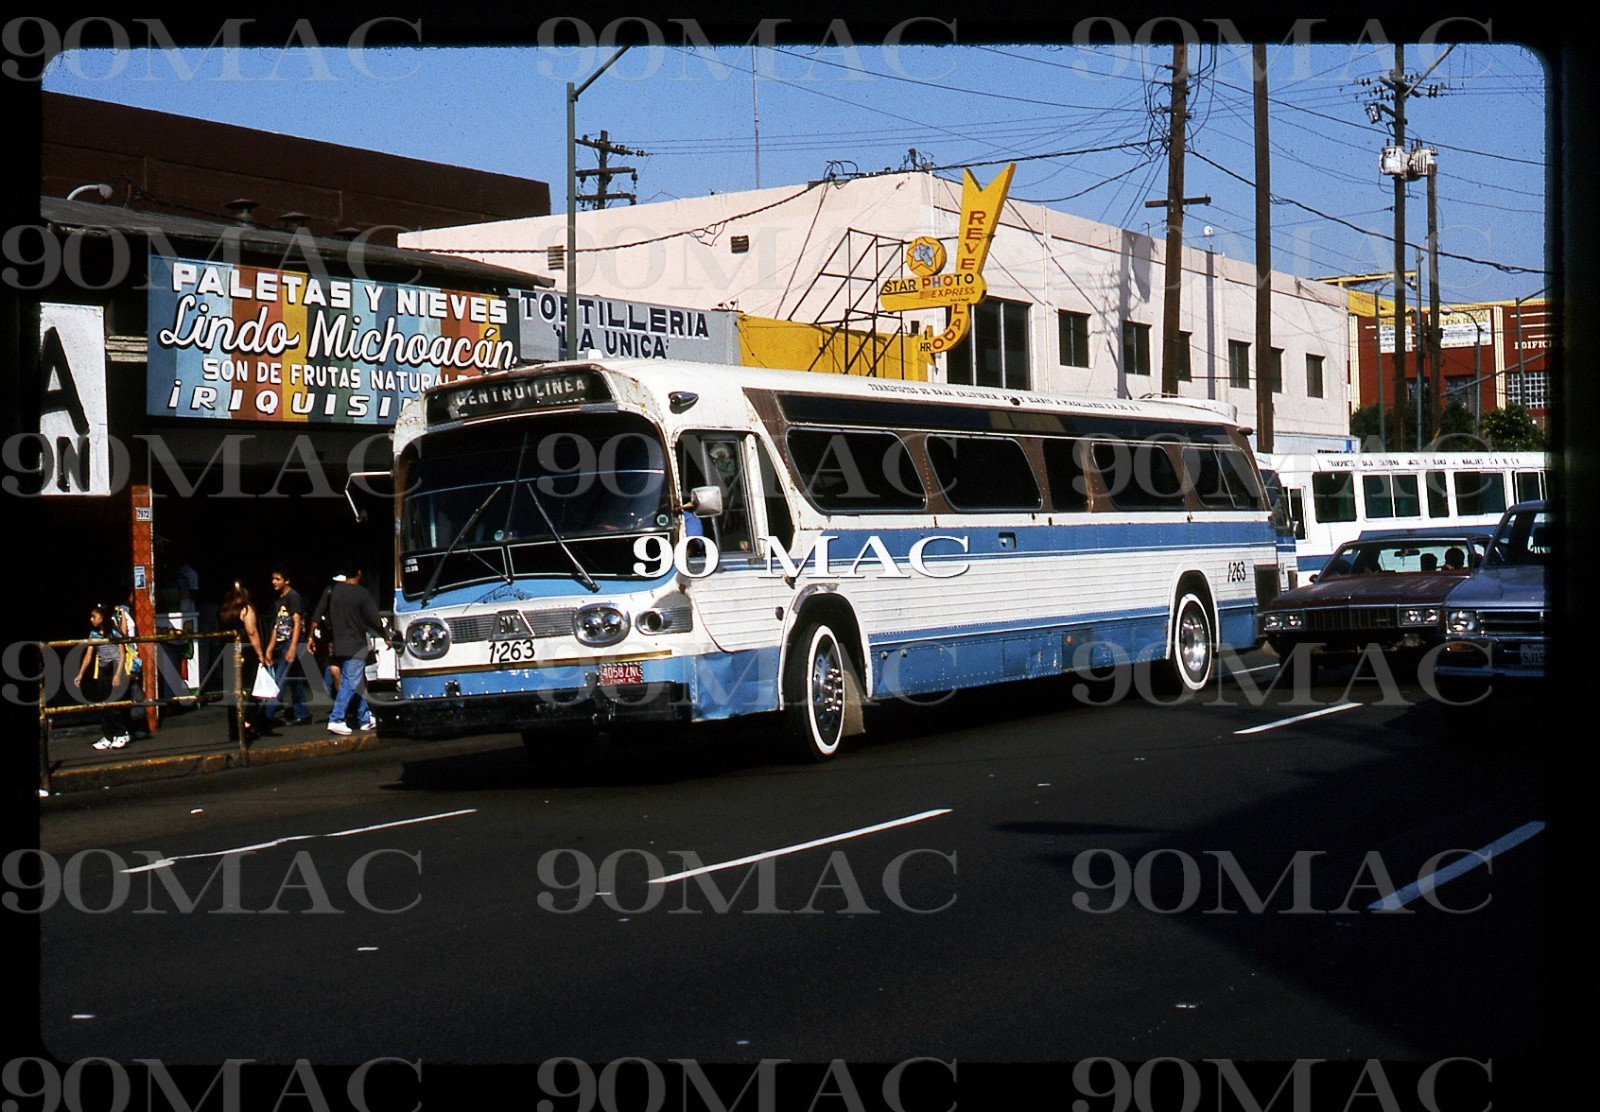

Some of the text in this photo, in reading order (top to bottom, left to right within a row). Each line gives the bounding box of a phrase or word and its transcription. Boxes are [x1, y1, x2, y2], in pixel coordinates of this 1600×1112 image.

[173, 262, 508, 324] PALETAS Y NIEVES
[885, 273, 975, 293] STAR PHOTO
[931, 287, 976, 298] EXPRESS
[519, 290, 710, 339] TORTILLERIA
[160, 294, 518, 369] Lindo Michoacán
[919, 341, 932, 352] HR
[202, 358, 249, 382] SON
[256, 360, 282, 385] DE
[290, 363, 362, 390] FRUTAS
